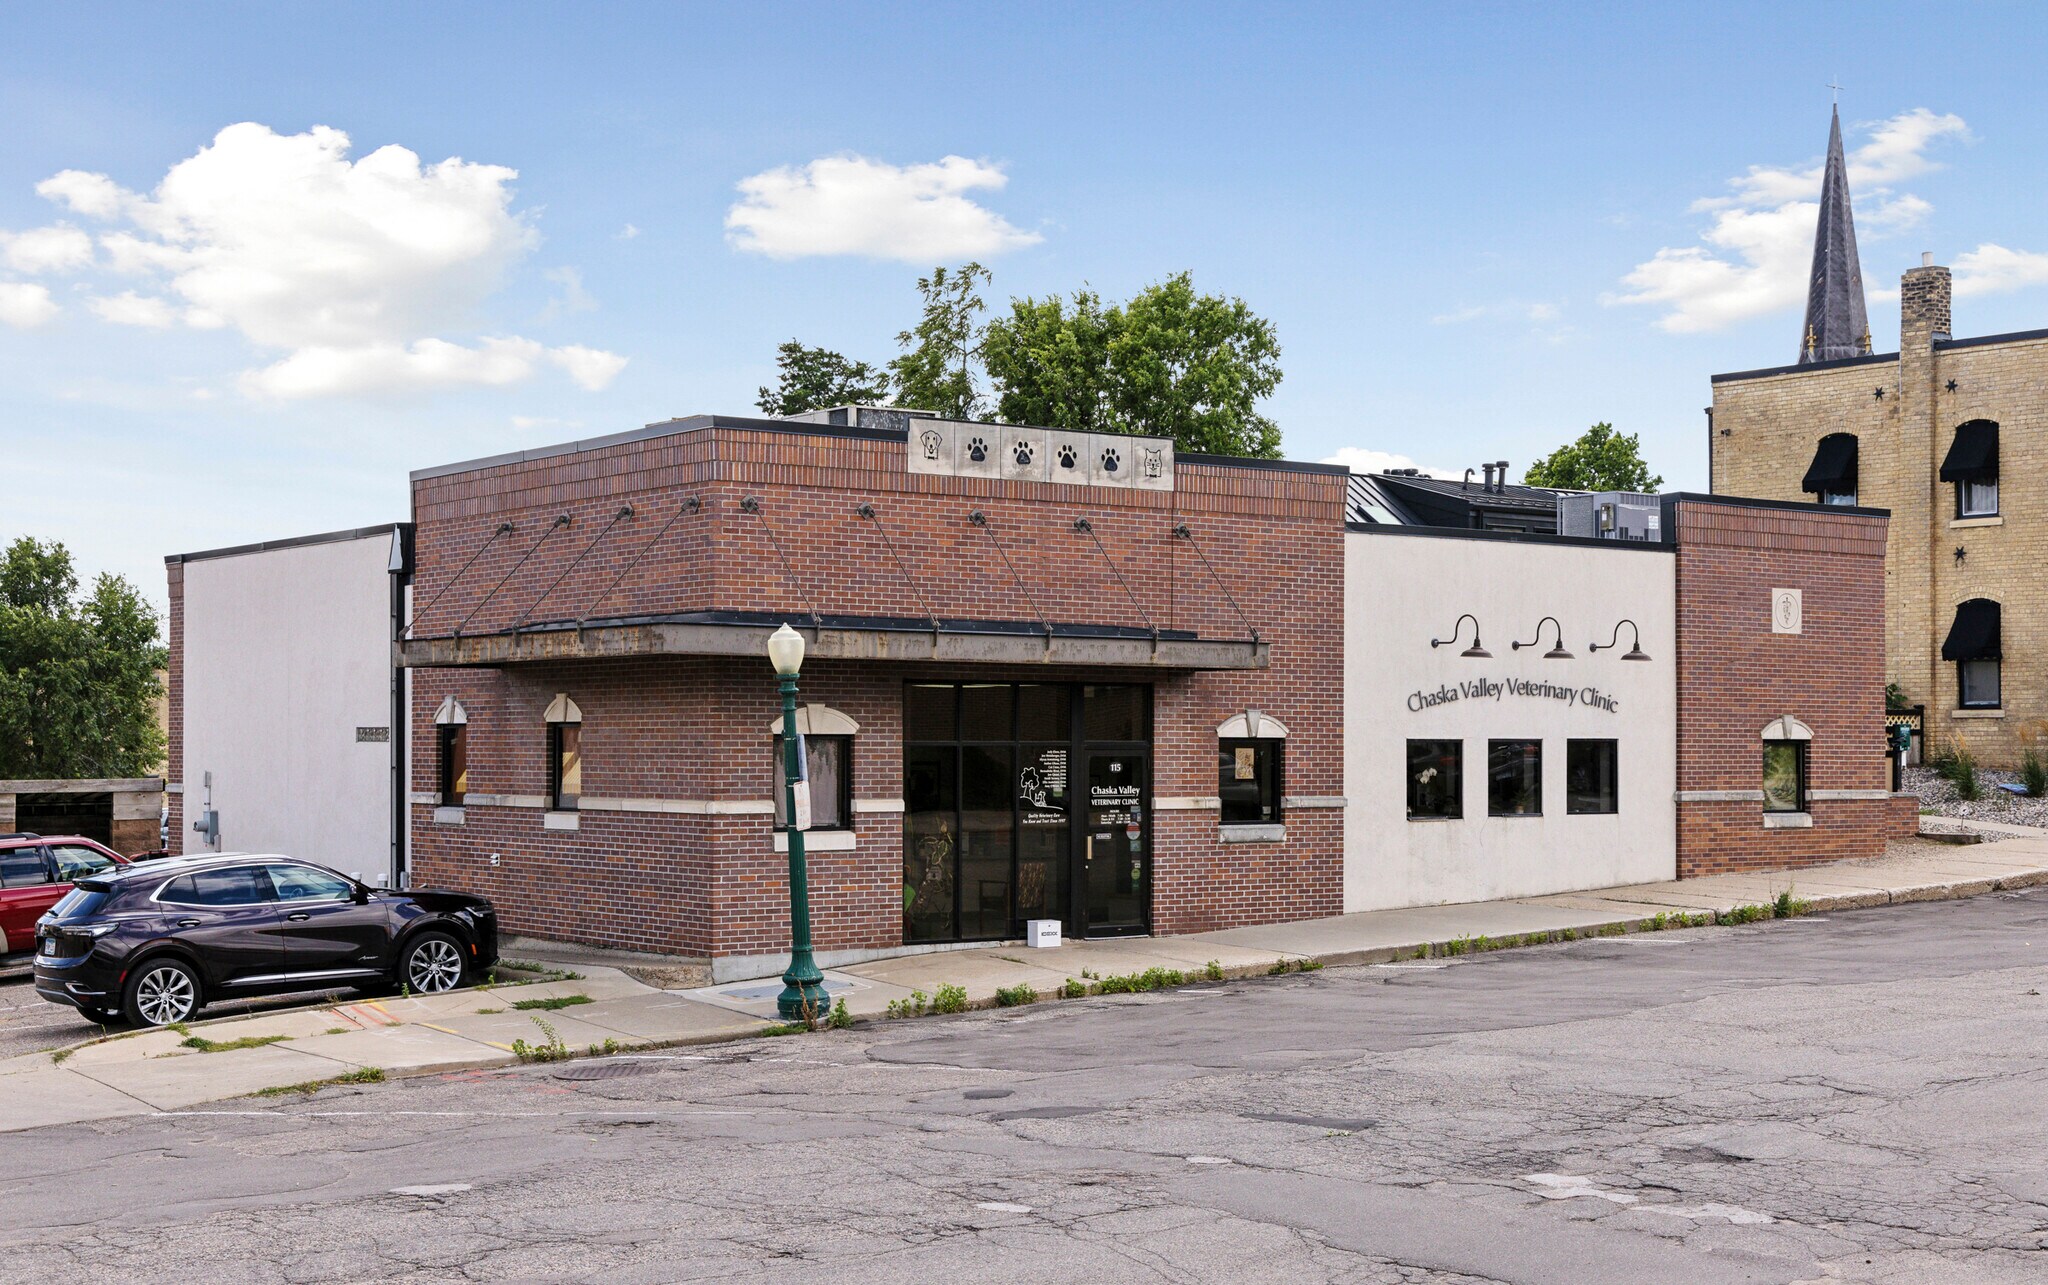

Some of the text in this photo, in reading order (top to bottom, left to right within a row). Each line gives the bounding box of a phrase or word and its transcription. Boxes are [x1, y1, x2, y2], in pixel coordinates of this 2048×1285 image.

[1407, 678, 1618, 714] Chaska Valley Veterinary Clinic
[1110, 764, 1121, 772] 115
[1091, 786, 1140, 796] Chaska Valley
